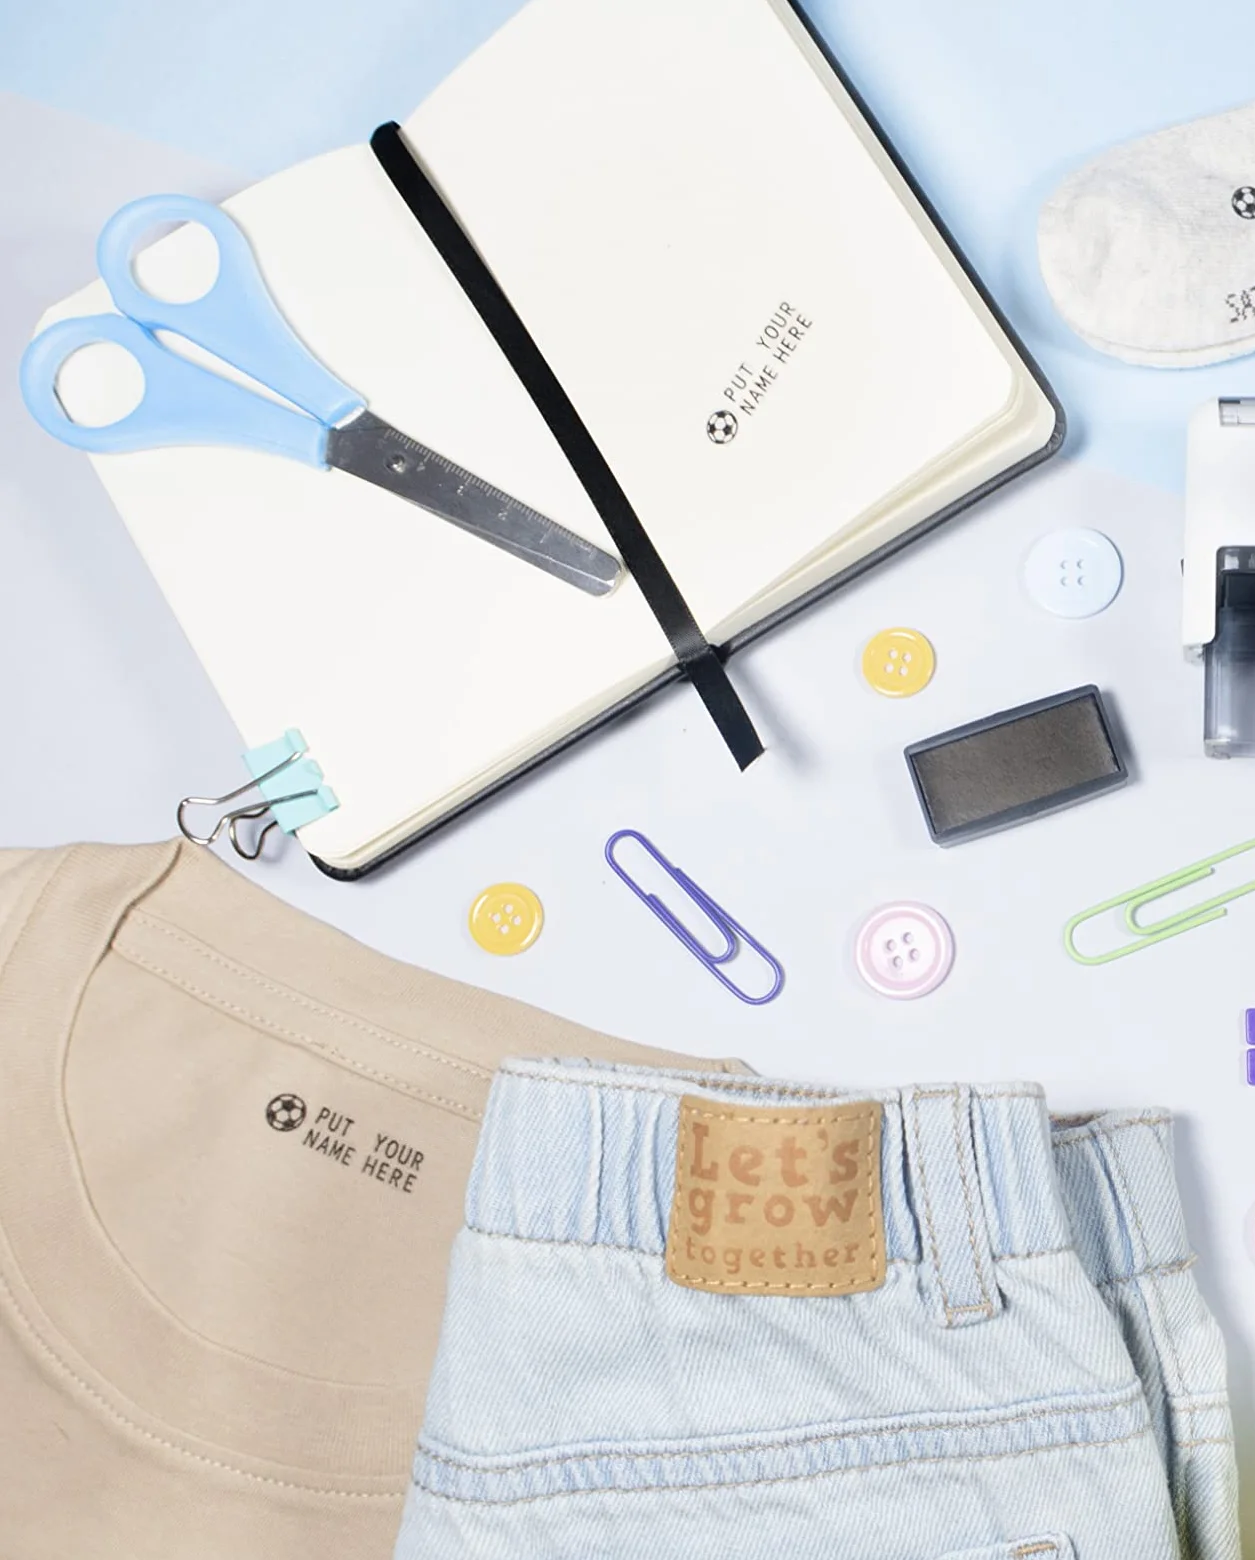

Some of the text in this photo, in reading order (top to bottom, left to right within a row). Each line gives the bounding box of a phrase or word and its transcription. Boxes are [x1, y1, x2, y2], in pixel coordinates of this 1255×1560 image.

[723, 301, 796, 403] PUT YOUR
[739, 313, 813, 416] NAME HERE
[302, 1128, 418, 1194] NAME HERE
[315, 1106, 425, 1172] PUT YOUR
[689, 1121, 861, 1188] Let's
[687, 1186, 860, 1236] grow
[685, 1236, 860, 1275] together
